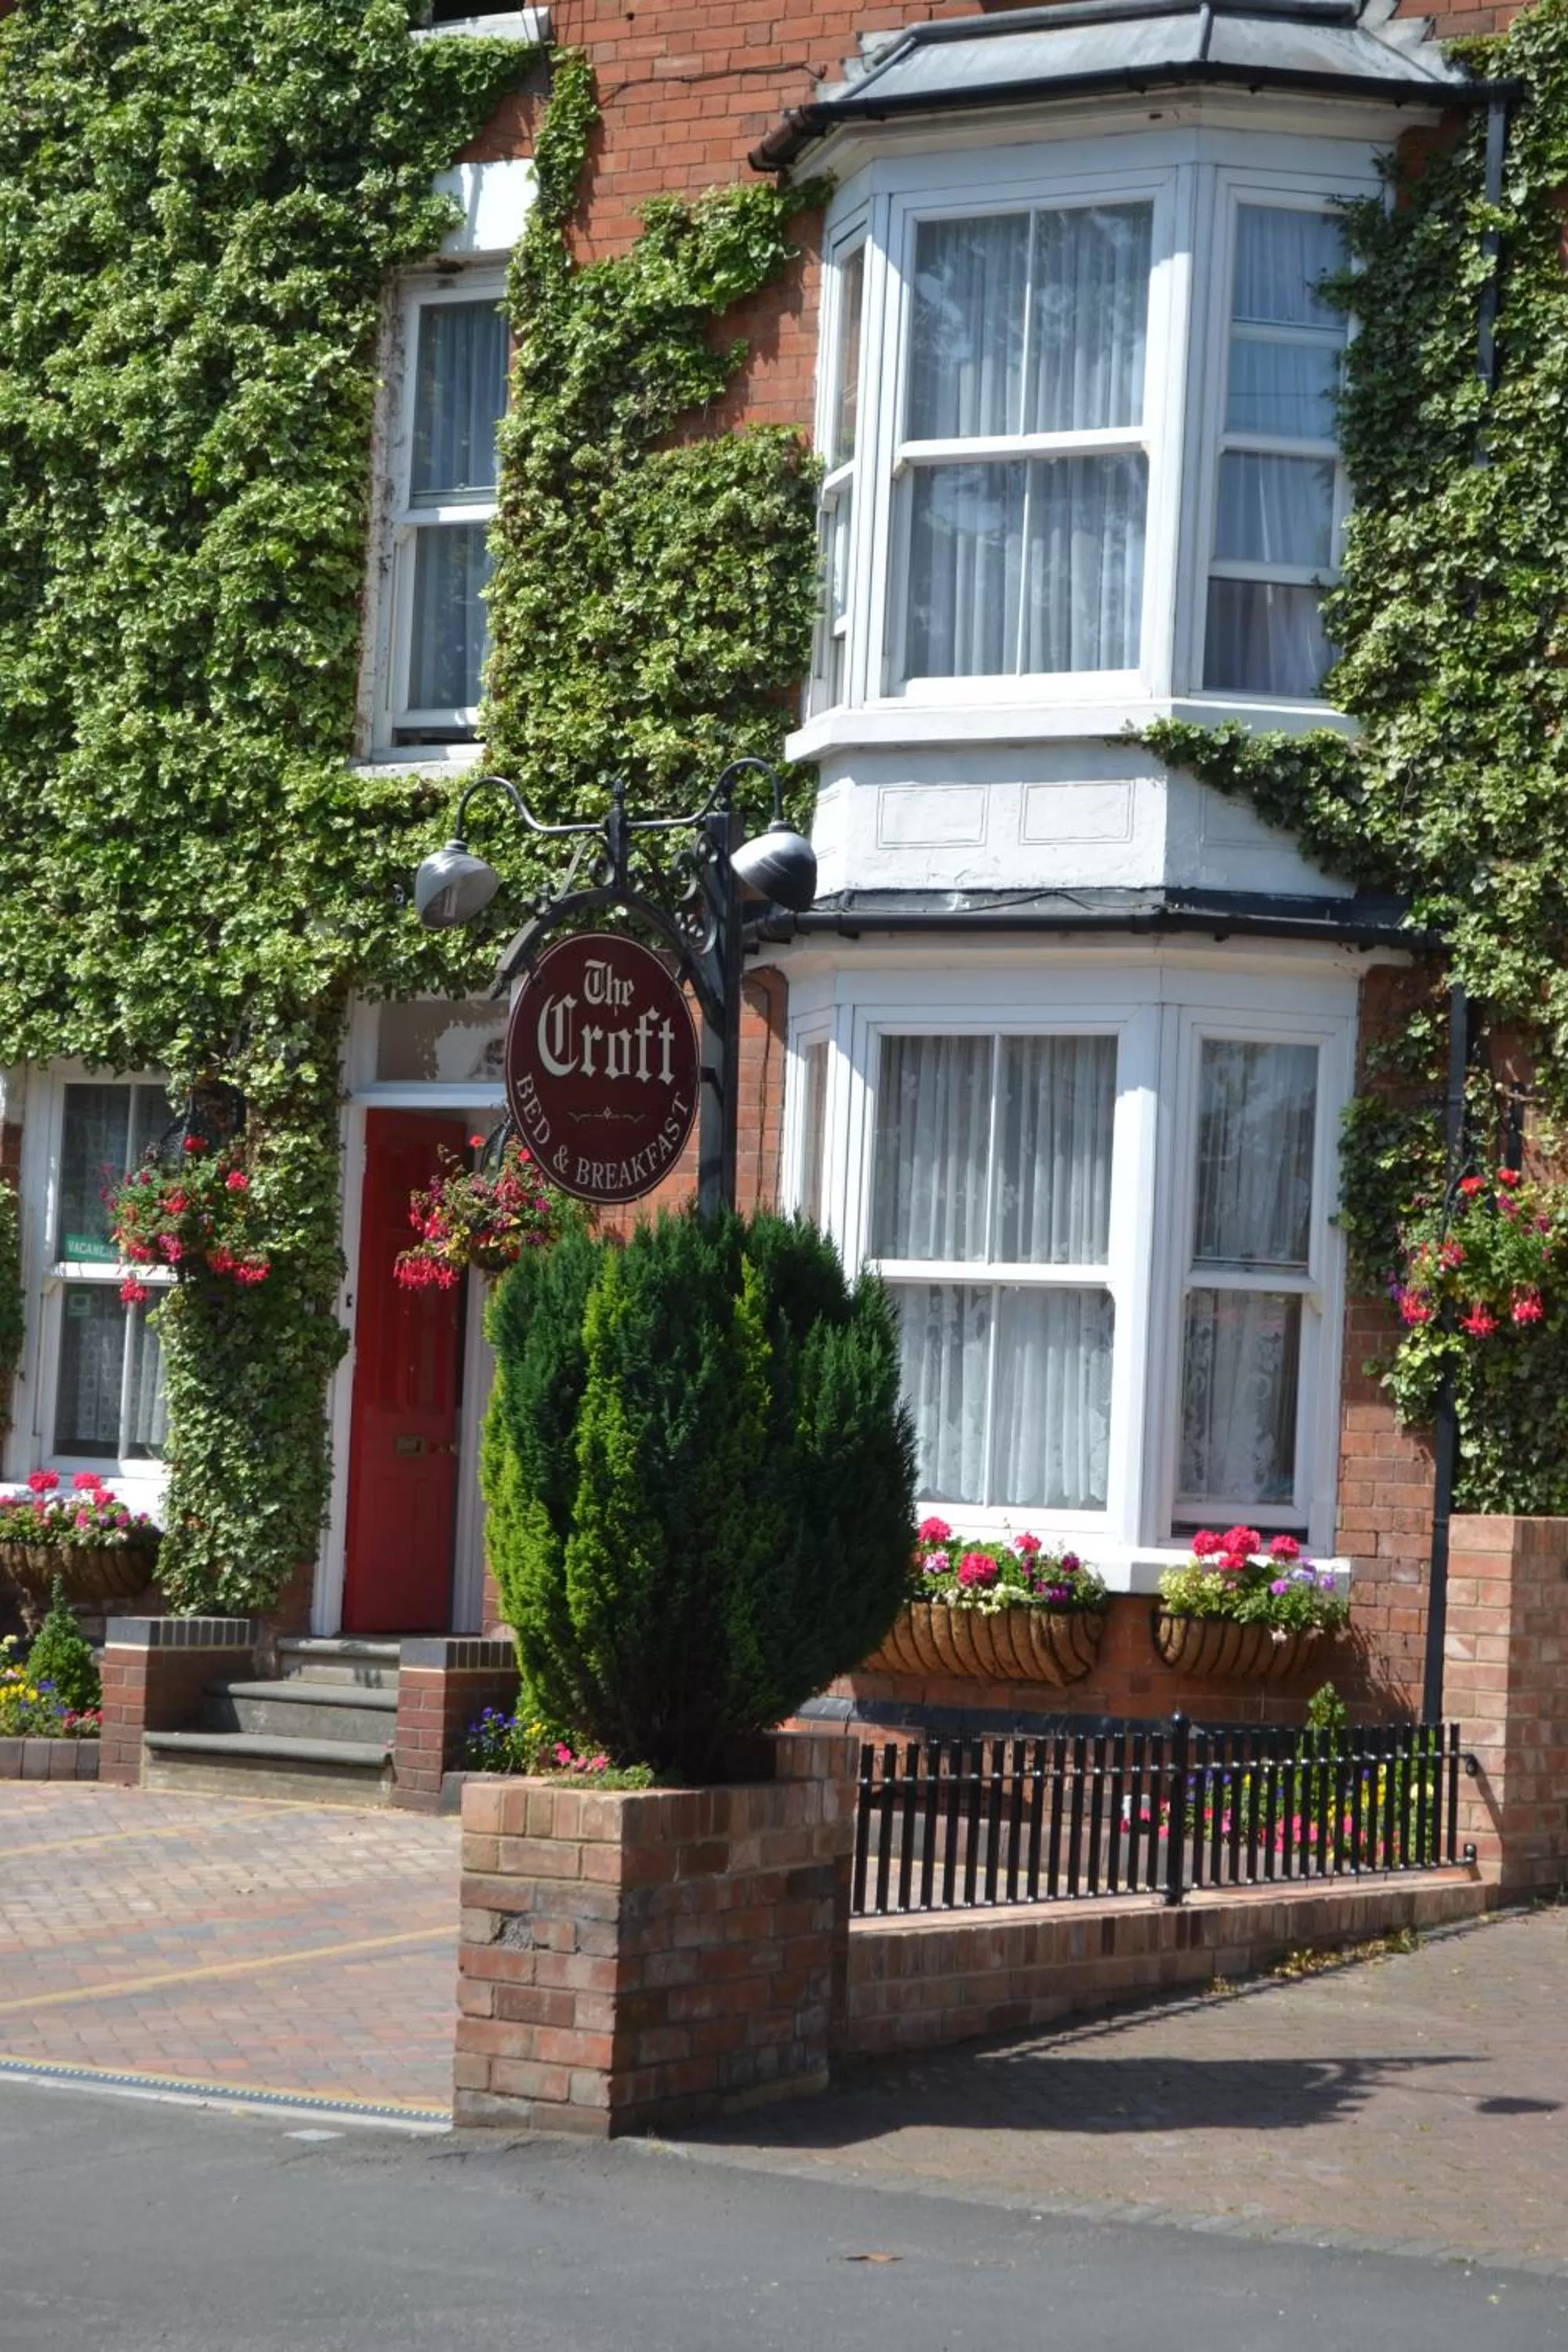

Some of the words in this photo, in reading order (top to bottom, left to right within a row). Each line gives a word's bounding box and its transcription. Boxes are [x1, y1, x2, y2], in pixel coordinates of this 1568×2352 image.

[584, 960, 635, 1014] The
[537, 993, 676, 1085] Croft
[517, 1073, 550, 1145] BED
[552, 1144, 570, 1174] &
[575, 1091, 690, 1189] BREAKFAST
